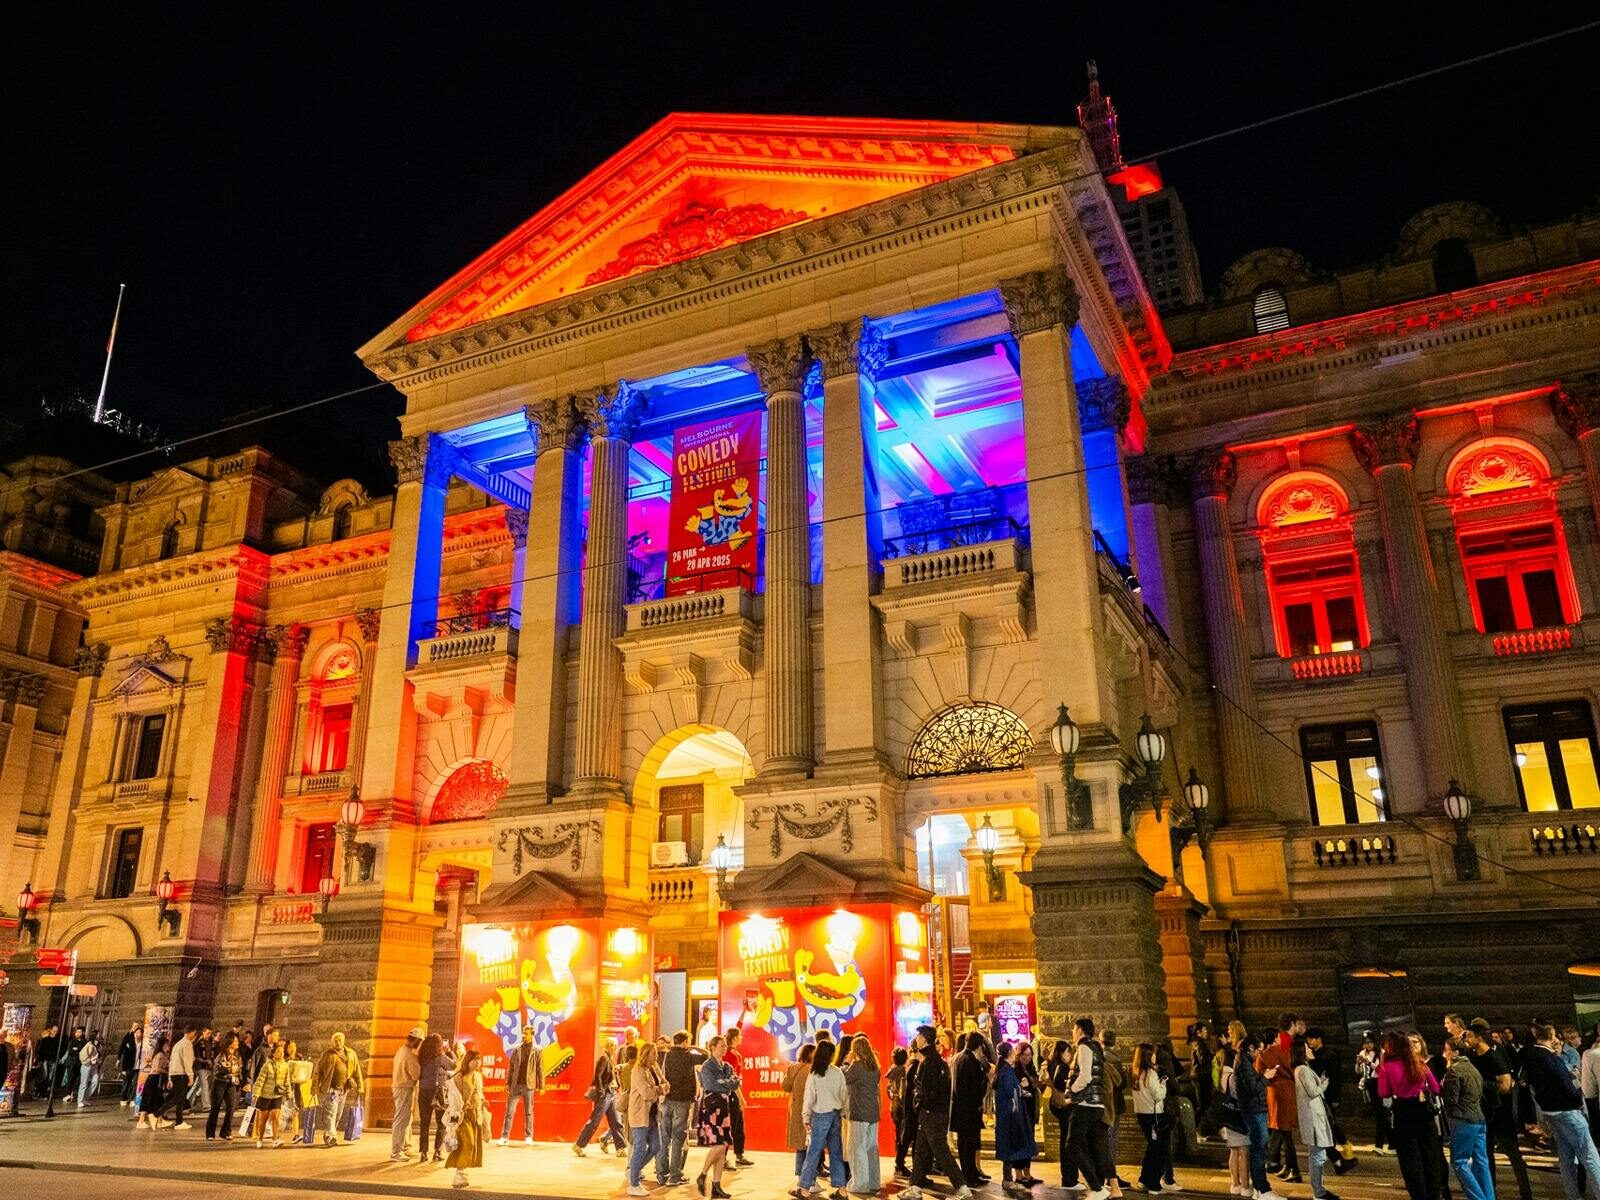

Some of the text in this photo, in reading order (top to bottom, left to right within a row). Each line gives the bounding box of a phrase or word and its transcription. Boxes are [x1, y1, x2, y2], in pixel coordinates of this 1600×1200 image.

[680, 421, 734, 444] MELBOURNE
[683, 430, 731, 448] INTERNATIONAL
[677, 432, 740, 476] COMEDY
[672, 547, 698, 563] 26 MAR
[696, 557, 711, 569] APR
[711, 554, 731, 567] 2025
[738, 927, 790, 960] COMEDY
[480, 963, 518, 985] FESTIVAL
[743, 953, 791, 977] FESTIVAL
[743, 1056, 770, 1070] 26 MAR
